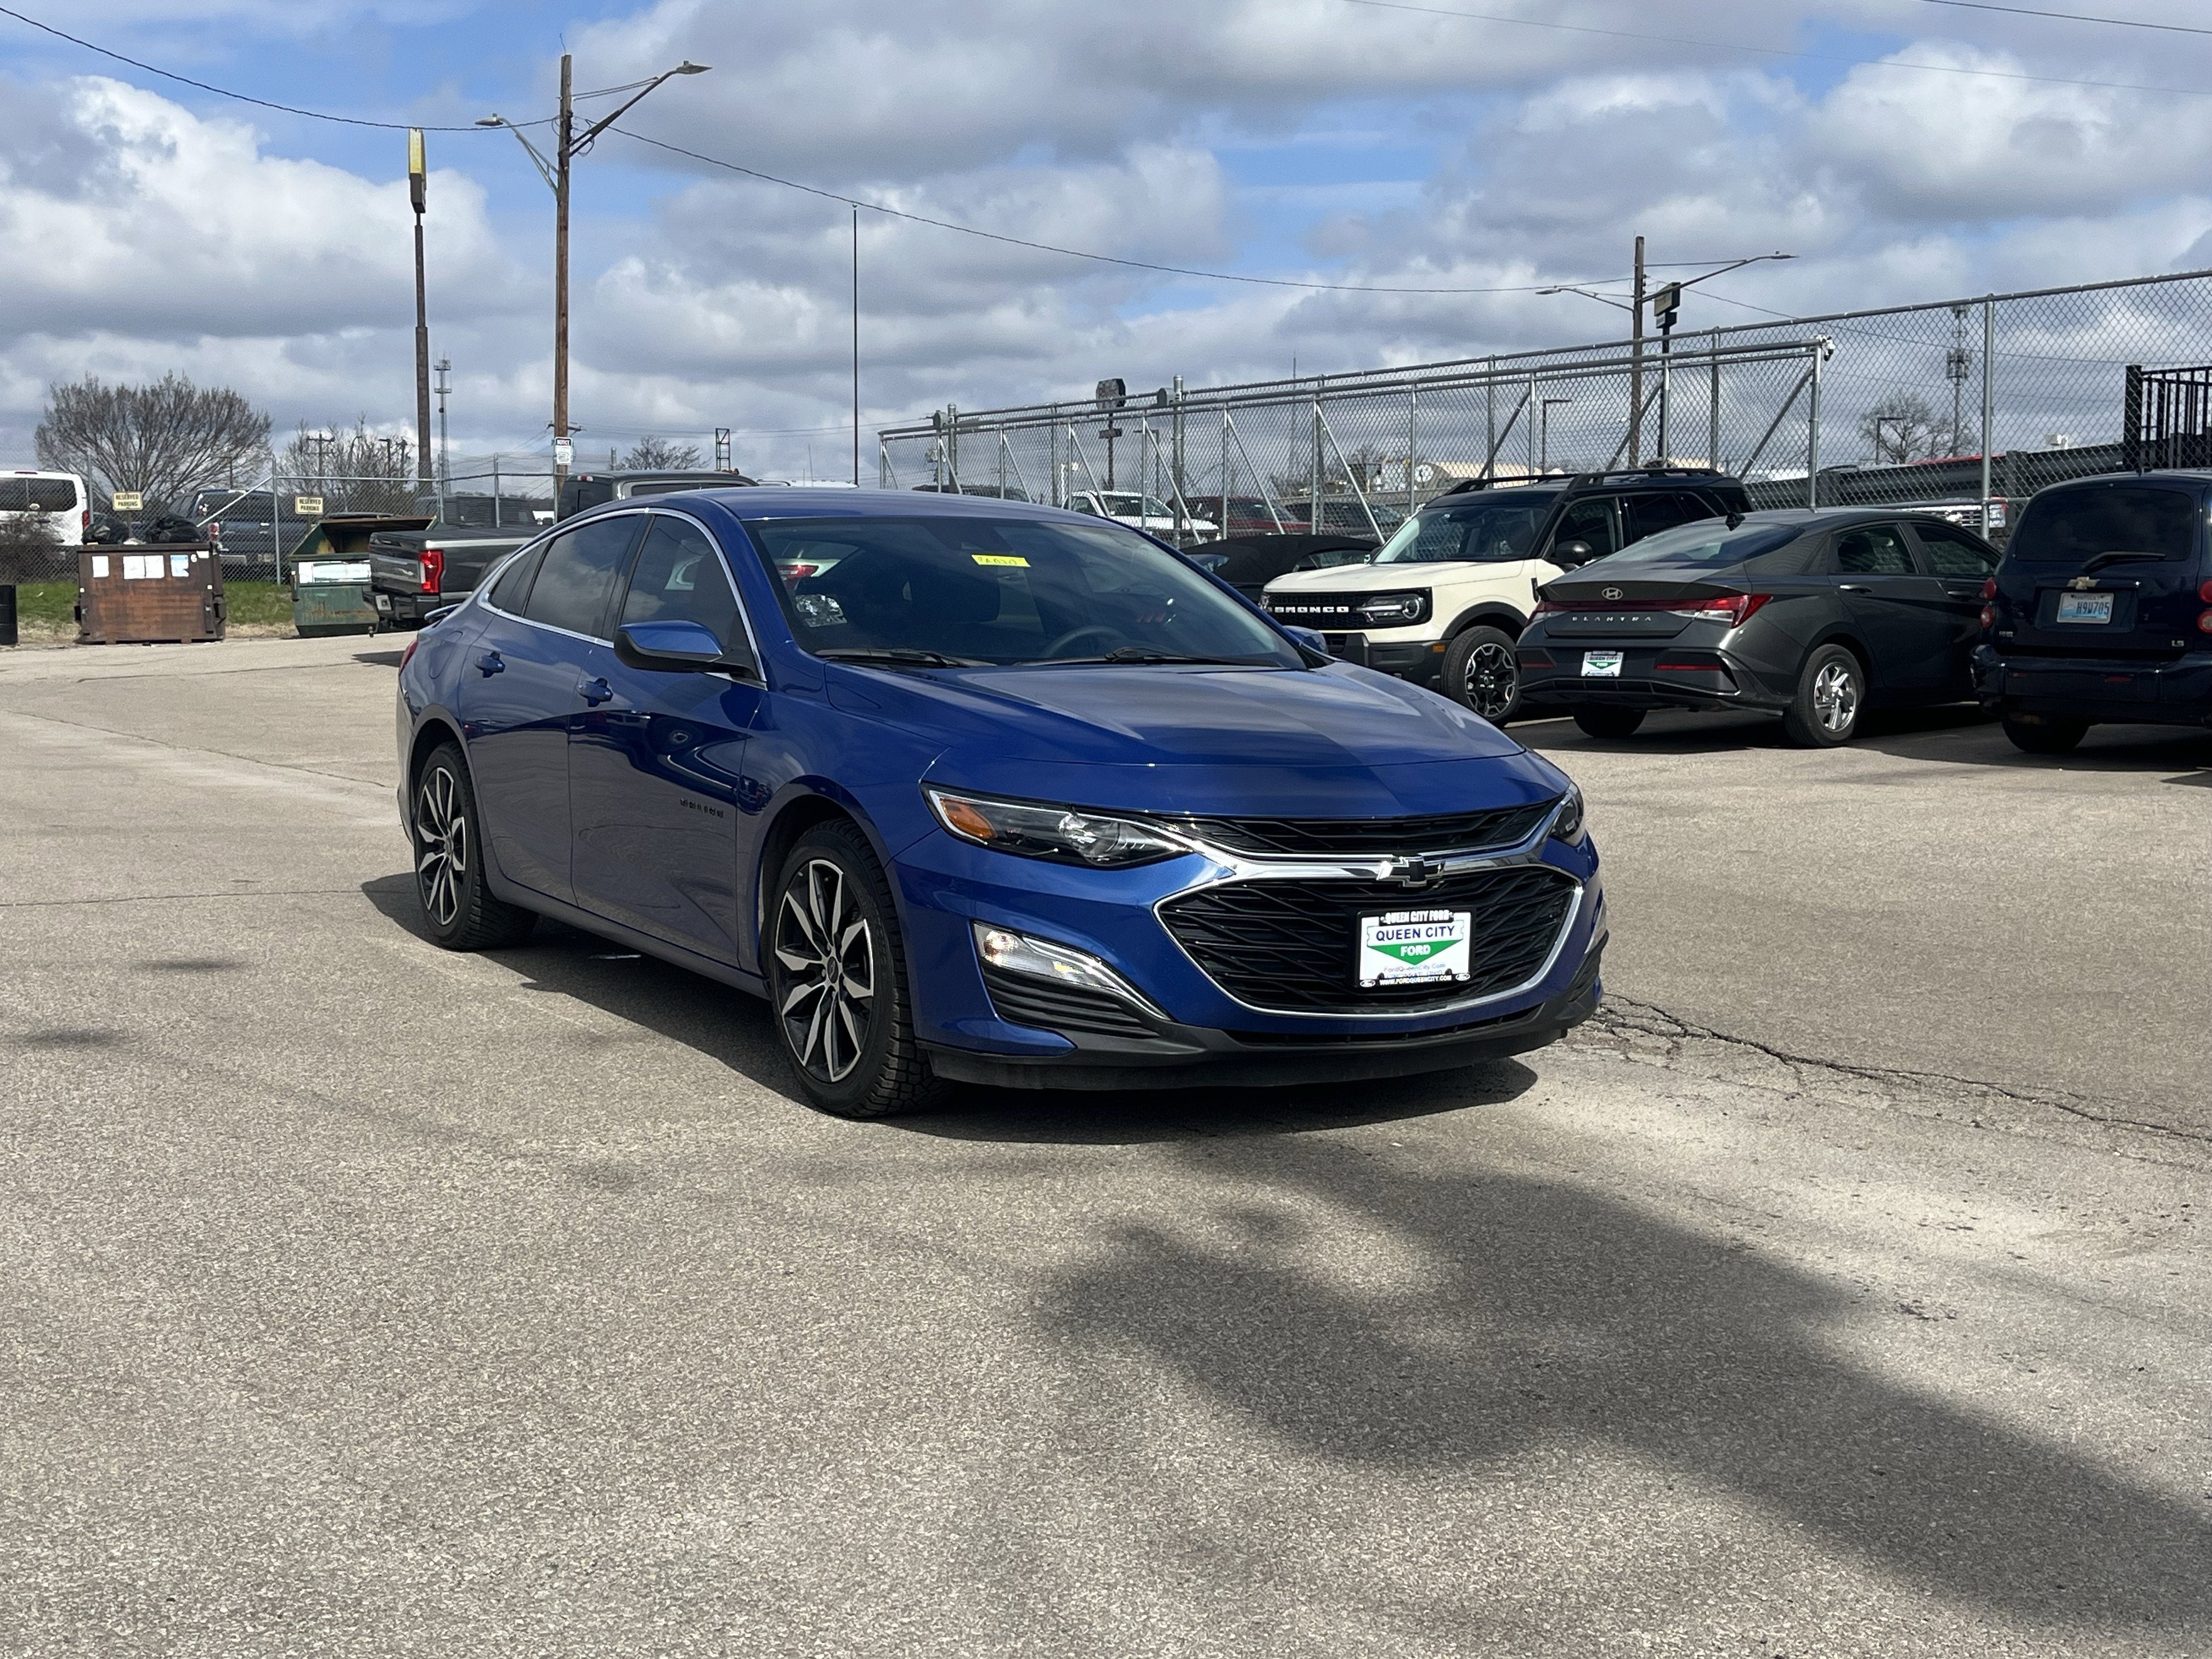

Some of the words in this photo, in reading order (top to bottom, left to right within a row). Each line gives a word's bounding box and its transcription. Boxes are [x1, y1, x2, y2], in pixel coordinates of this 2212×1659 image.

[2075, 601, 2109, 614] H9W705
[1384, 911, 1410, 924] QUEEN
[1410, 910, 1429, 922] CITY
[1429, 909, 1449, 921] FORD
[1376, 928, 1421, 941] QUEEN
[1426, 926, 1455, 938] CITY
[1400, 944, 1431, 957] FORD
